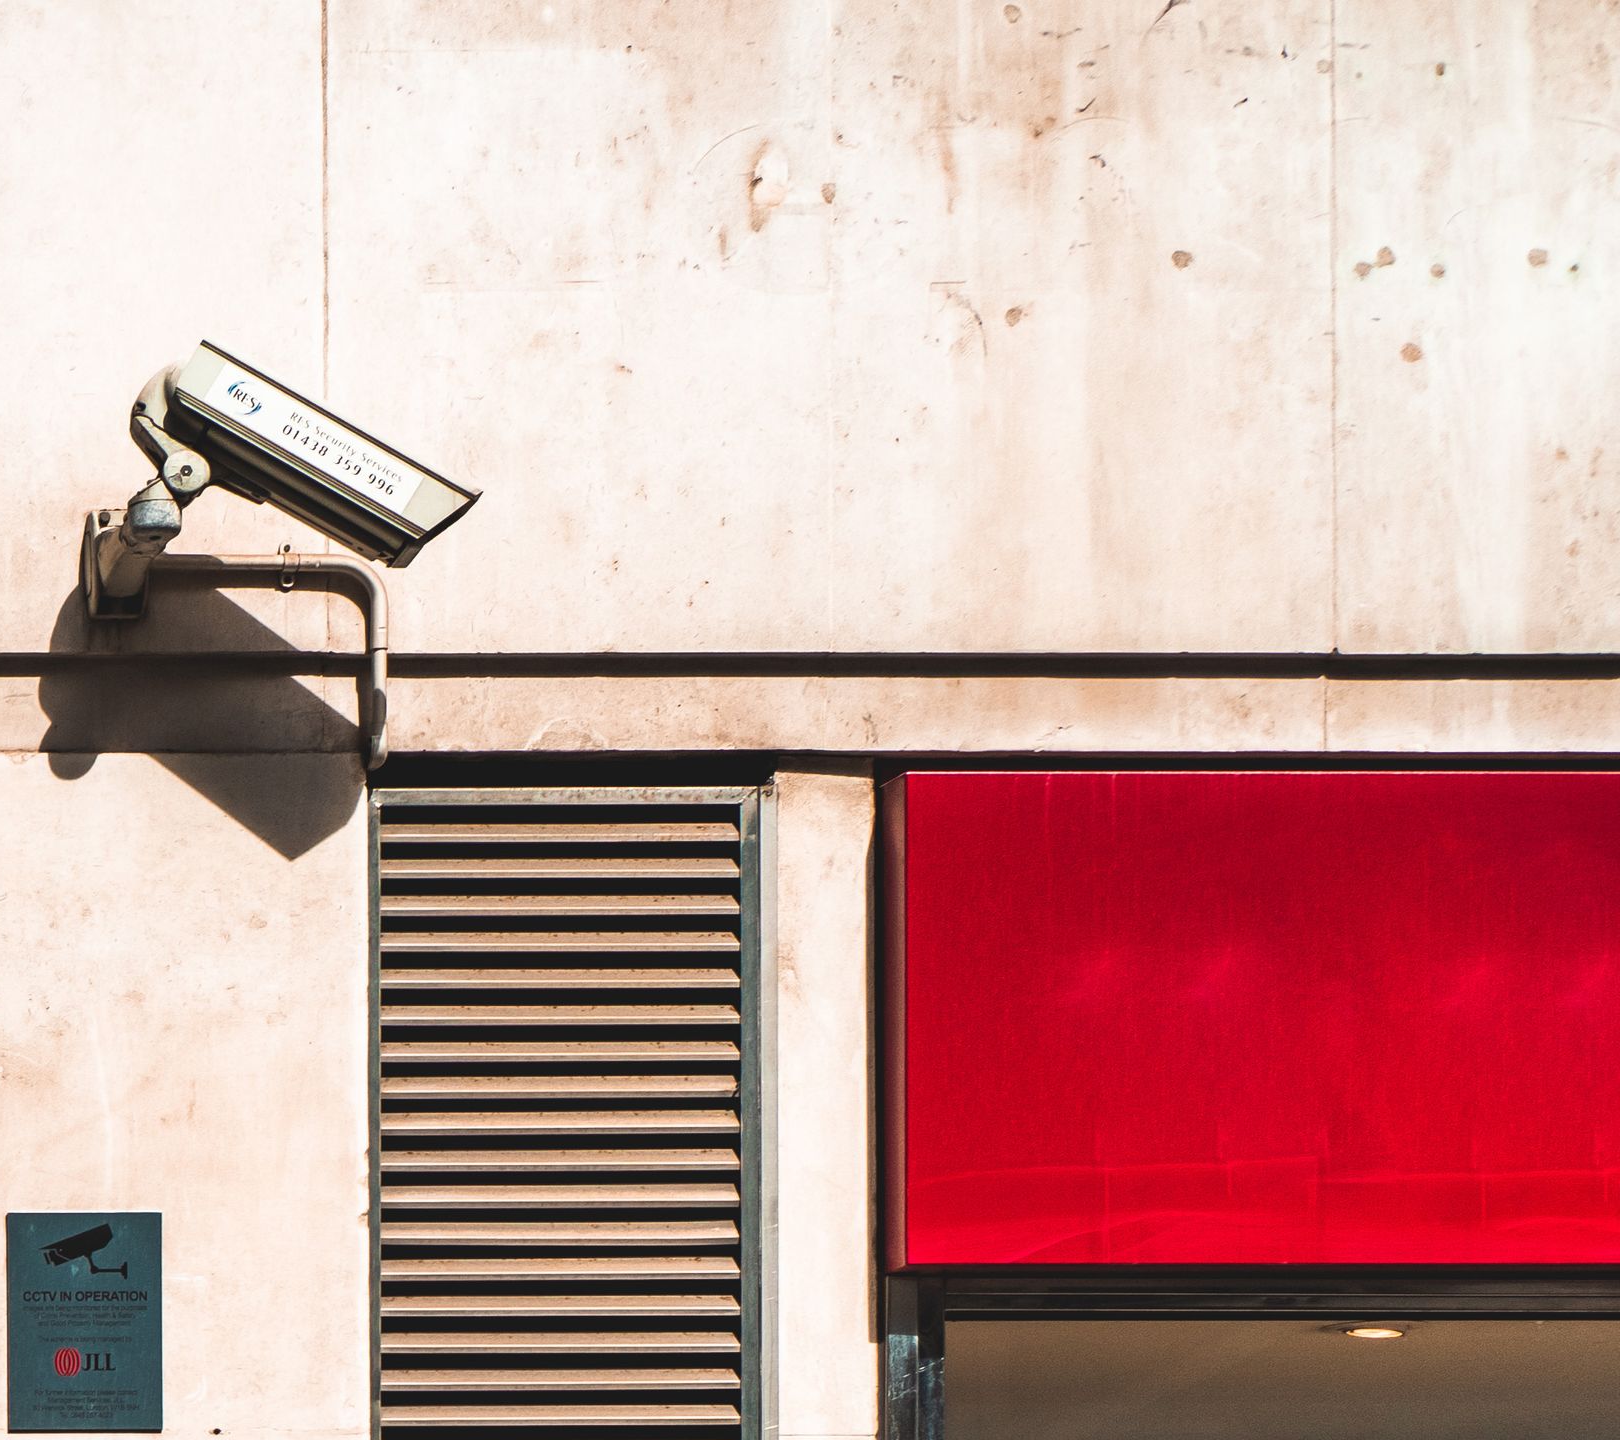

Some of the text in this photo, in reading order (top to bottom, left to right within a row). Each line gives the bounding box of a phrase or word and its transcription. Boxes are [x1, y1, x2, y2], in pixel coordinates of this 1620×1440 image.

[233, 388, 256, 408] RES
[290, 412, 402, 483] RES Security Services
[282, 424, 395, 496] 01438 359 996
[23, 1291, 147, 1302] CCTV IN OPERATION
[82, 1353, 116, 1371] JLL
